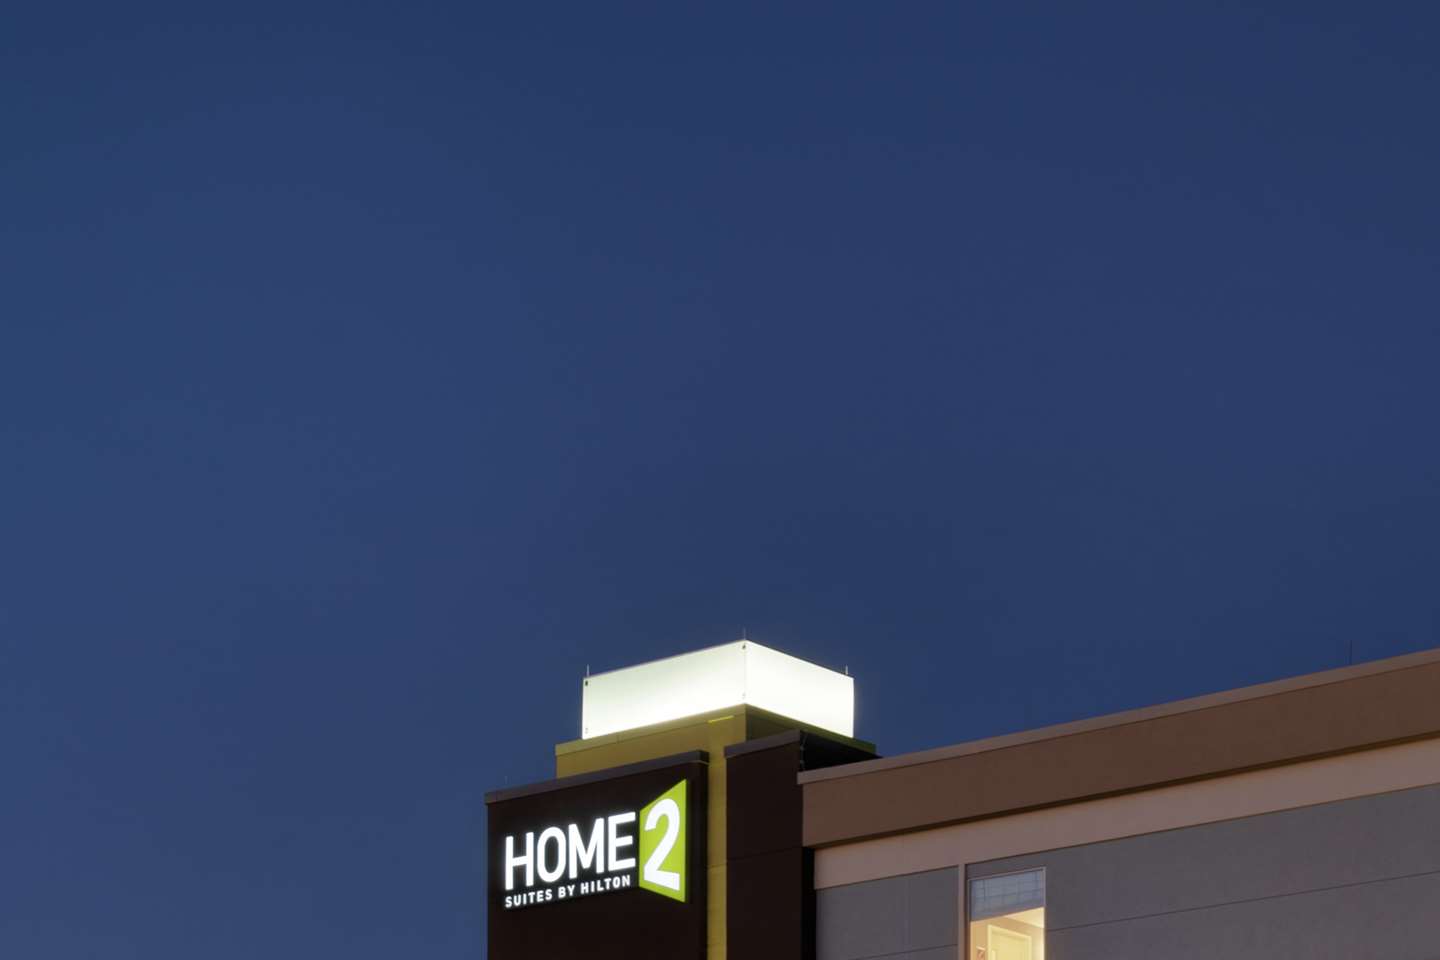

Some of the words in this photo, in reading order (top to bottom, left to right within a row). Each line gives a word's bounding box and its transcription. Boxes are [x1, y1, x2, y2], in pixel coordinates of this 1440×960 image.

[505, 812, 636, 890] HOME
[643, 798, 680, 891] 2
[505, 889, 553, 908] SUITES
[558, 885, 575, 899] BY
[580, 874, 631, 894] HILTON
